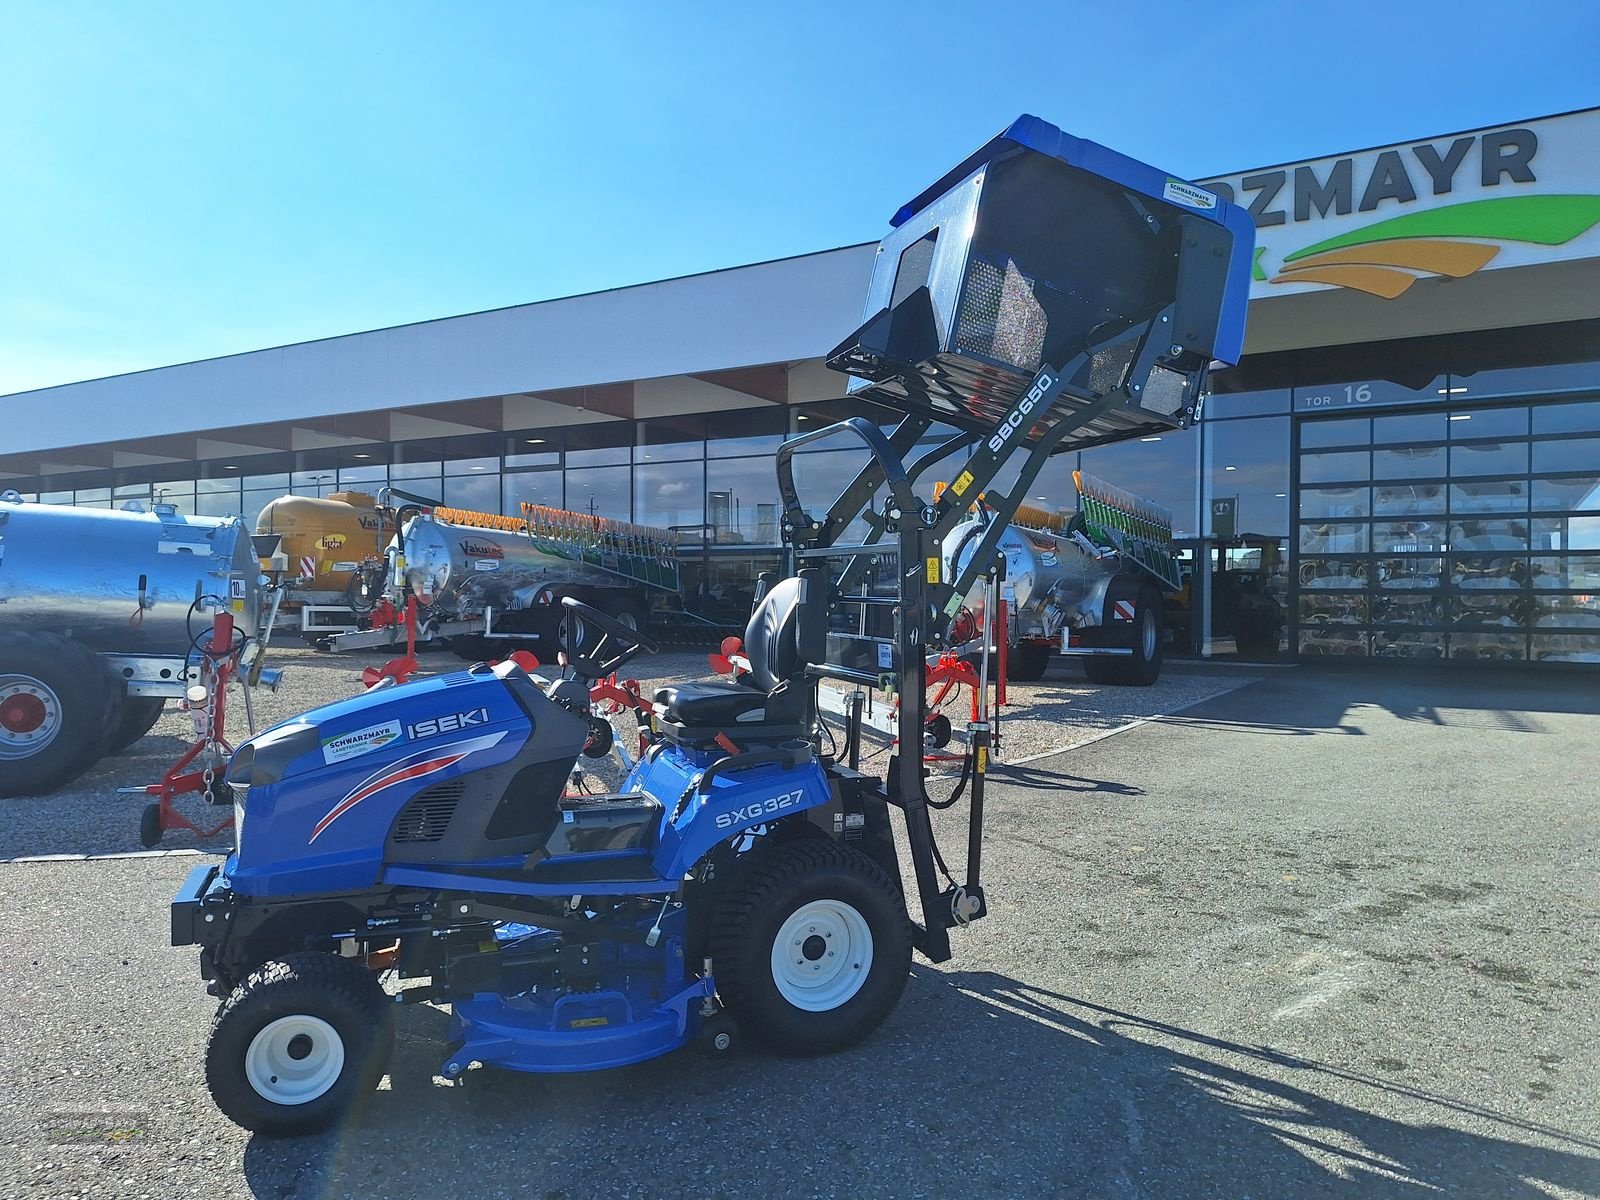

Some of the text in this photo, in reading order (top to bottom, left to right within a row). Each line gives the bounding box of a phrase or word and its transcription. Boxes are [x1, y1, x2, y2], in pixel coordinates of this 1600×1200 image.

[1170, 183, 1210, 202] SCHWARZMAYR
[1305, 383, 1372, 406] TOR 16
[988, 374, 1053, 453] SBC650
[321, 536, 343, 551] light
[459, 540, 504, 557] Vakutec
[232, 581, 240, 597] 10
[407, 707, 490, 741] ISEKI
[329, 727, 391, 749] SCHWARZMAYR
[715, 788, 805, 829] SXG327
